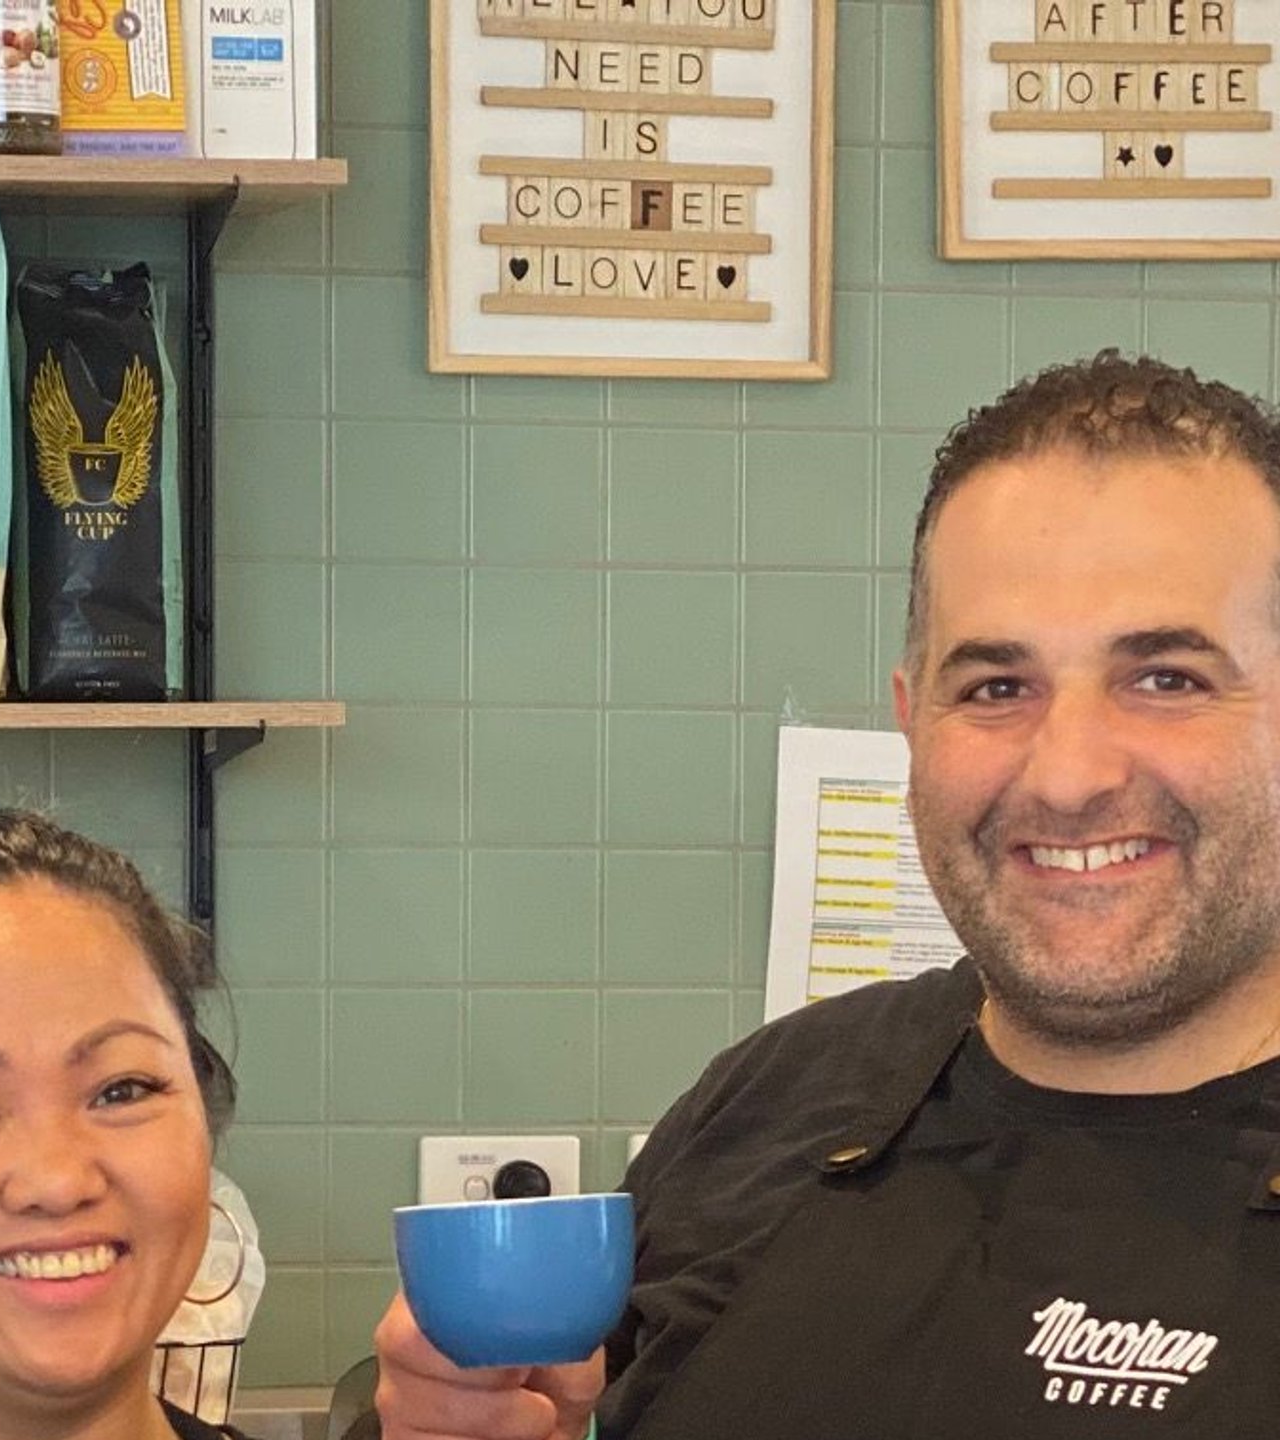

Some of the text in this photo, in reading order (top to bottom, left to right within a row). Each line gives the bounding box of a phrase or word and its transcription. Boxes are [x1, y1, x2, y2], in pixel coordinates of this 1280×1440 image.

[209, 6, 285, 25] MILKLAB
[1043, 2, 1224, 36] AFTER
[553, 49, 705, 85] NEED
[1016, 69, 1247, 104] COFFEE
[602, 118, 658, 154] IS
[514, 184, 746, 228] COFFEE
[552, 253, 697, 292] LOVE
[85, 458, 106, 471] FC
[64, 512, 128, 525] FLYING
[77, 527, 114, 540] CUP
[1024, 1297, 1219, 1384] Mocopan
[1043, 1376, 1170, 1410] COFFEE
